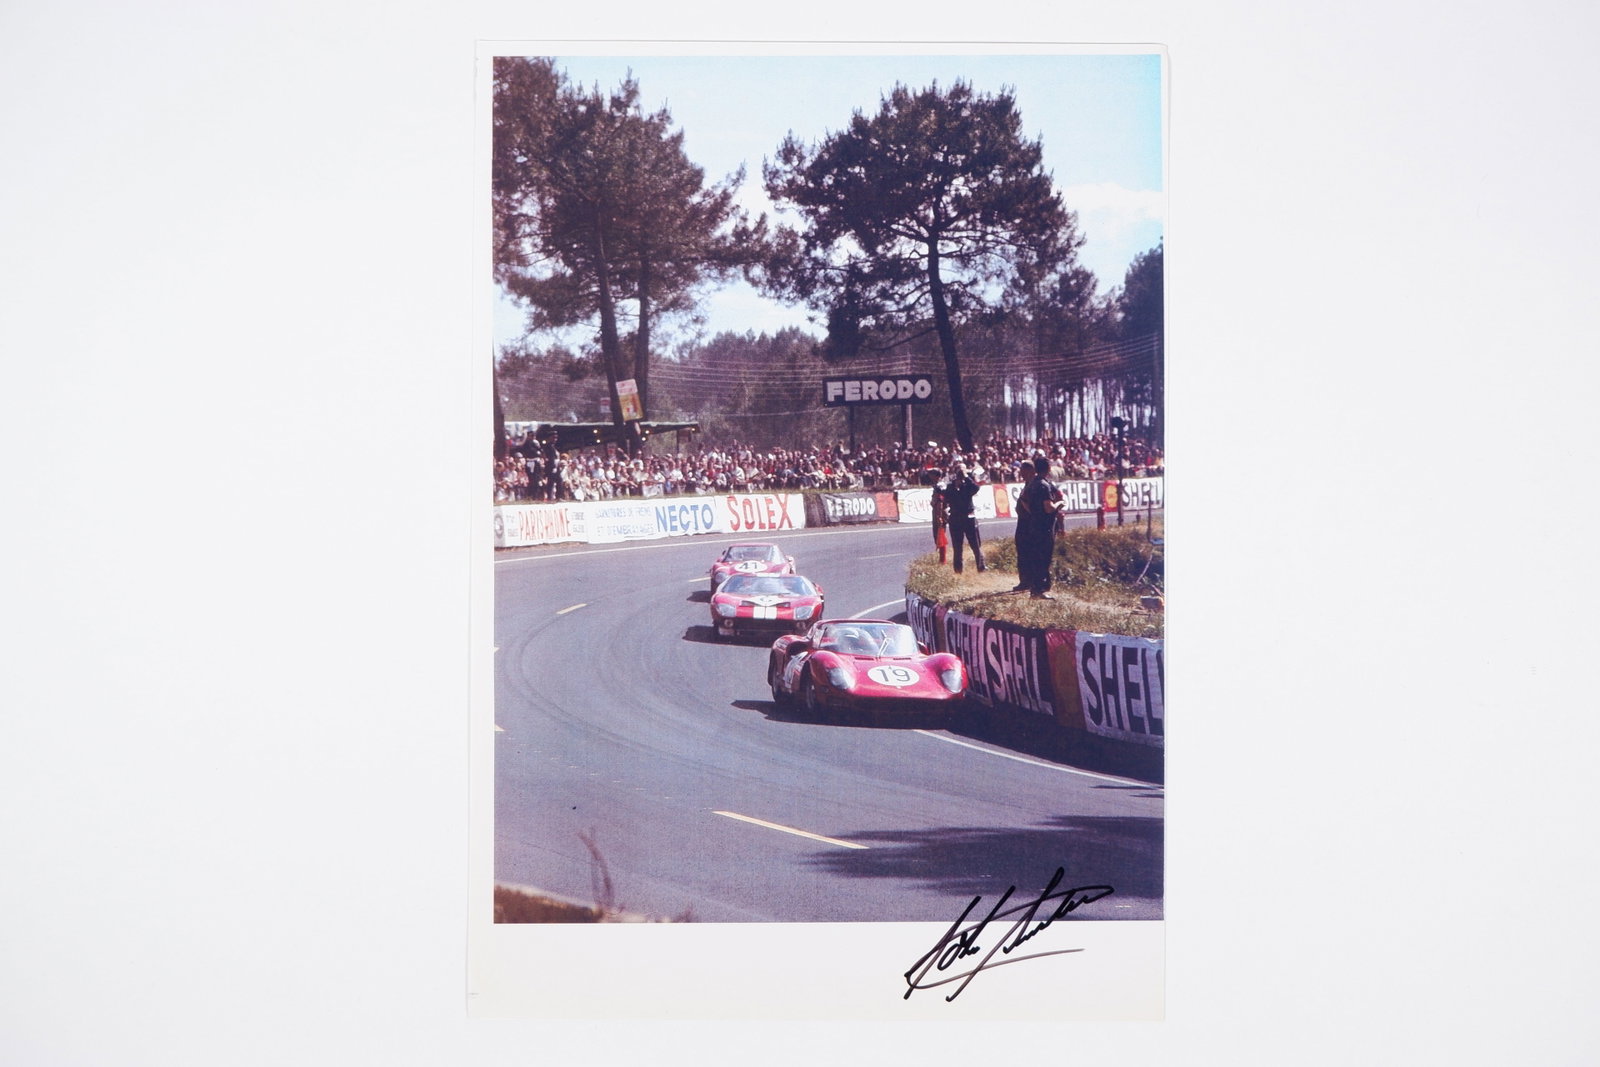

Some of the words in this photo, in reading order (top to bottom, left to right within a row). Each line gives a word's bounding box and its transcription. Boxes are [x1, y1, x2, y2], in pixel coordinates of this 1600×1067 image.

[827, 379, 932, 401] FERODO
[1058, 482, 1102, 510] SHELL
[1121, 481, 1161, 507] SHELL
[655, 503, 713, 532] NECTO
[726, 494, 793, 531] SOLEX
[826, 498, 876, 517] FERODO
[737, 560, 759, 572] 41
[877, 668, 910, 682] 19
[986, 627, 1054, 716] SHELL
